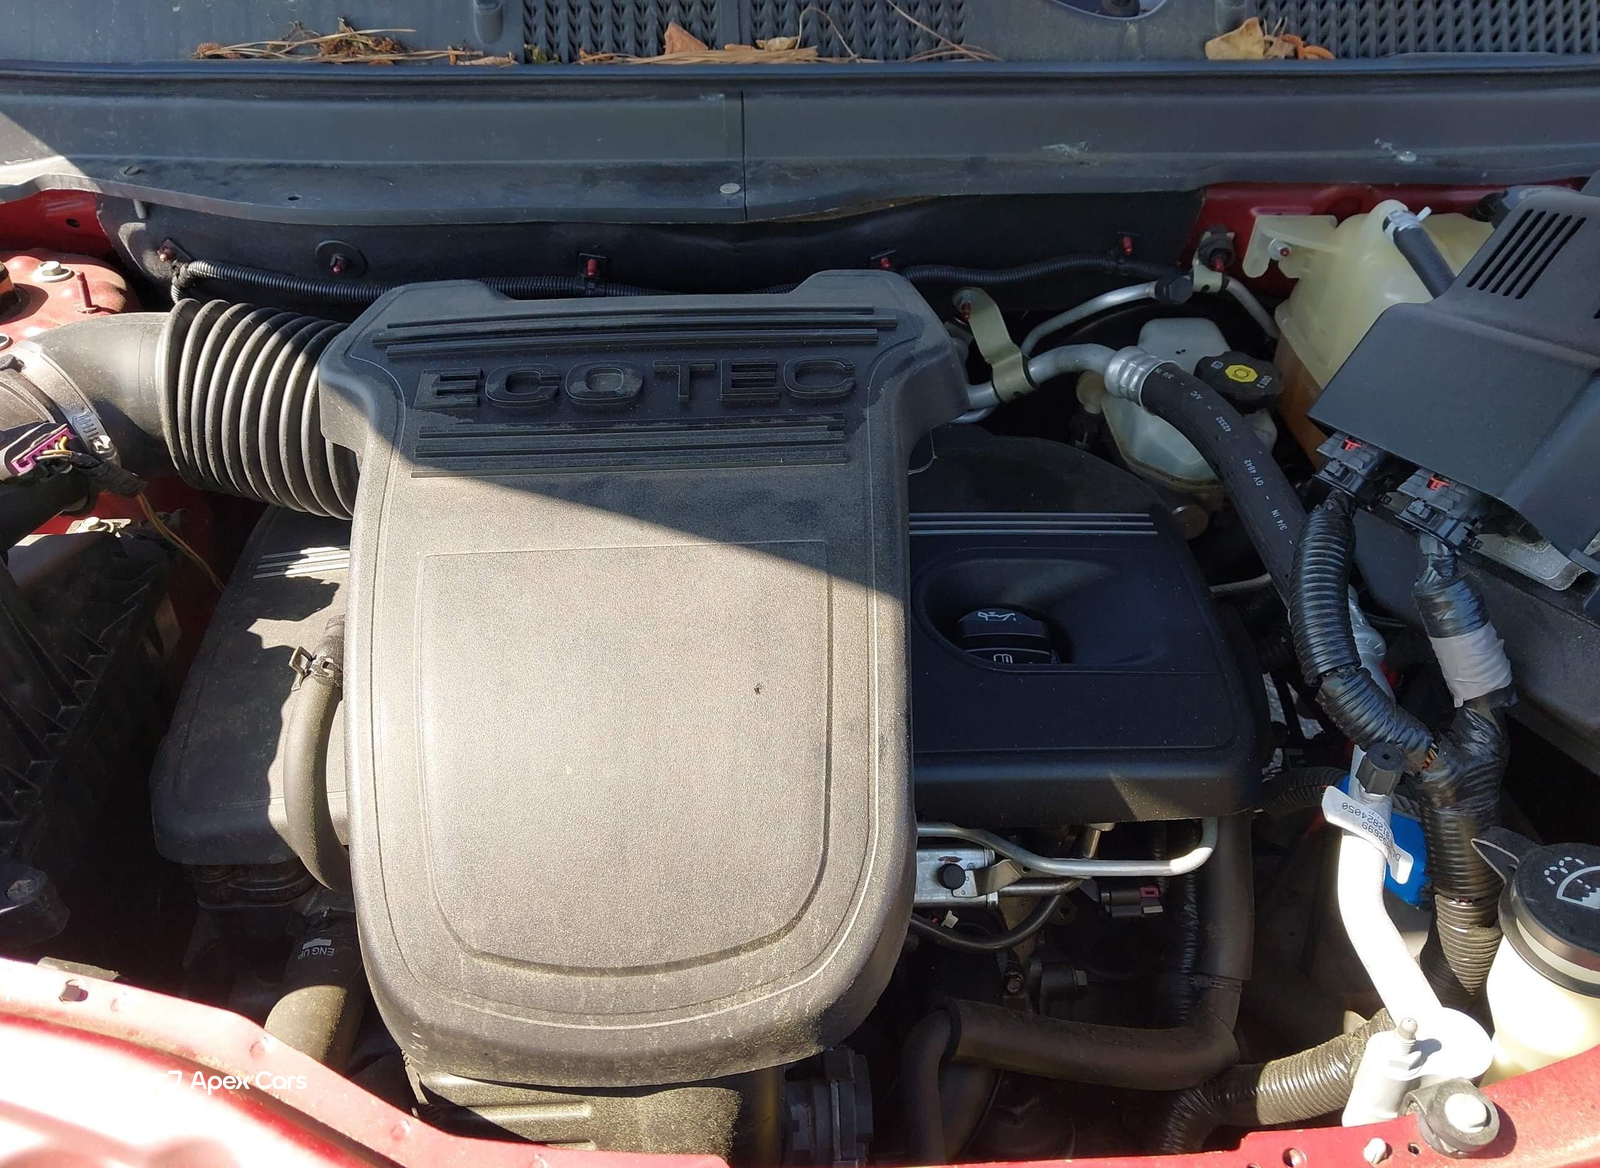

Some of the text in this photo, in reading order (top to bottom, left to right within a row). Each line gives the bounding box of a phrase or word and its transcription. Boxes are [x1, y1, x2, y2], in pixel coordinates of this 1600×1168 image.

[413, 355, 857, 409] ECOTEC
[1271, 509, 1281, 518] IN
[297, 946, 335, 960] ENG UP
